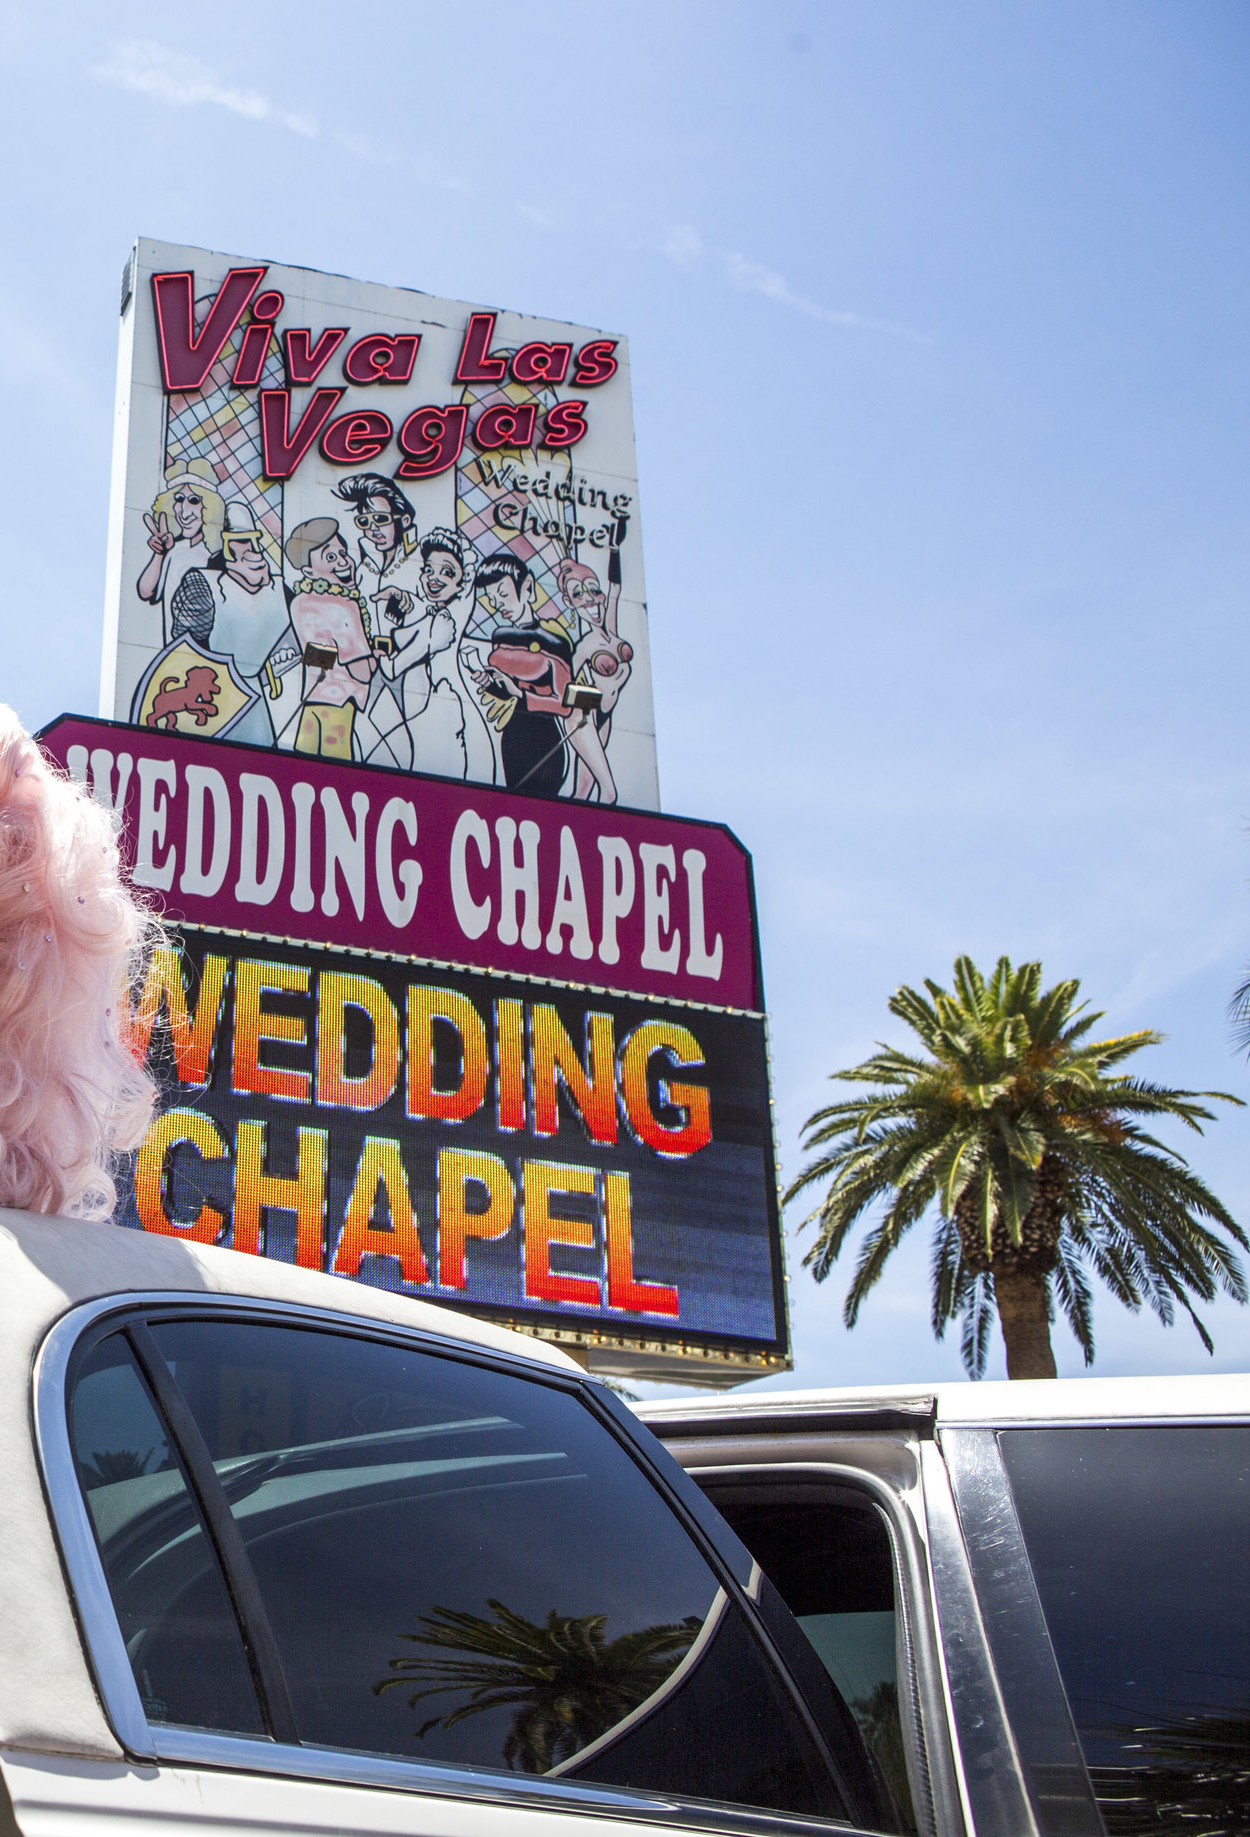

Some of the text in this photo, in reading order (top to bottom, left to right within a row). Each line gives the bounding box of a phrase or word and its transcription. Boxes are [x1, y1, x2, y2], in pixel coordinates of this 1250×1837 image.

[151, 265, 620, 395] Viva Las
[258, 386, 589, 481] Vegas
[477, 458, 633, 521] Wedding
[493, 501, 620, 550] Chapel
[450, 809, 724, 981] CHAPEL
[118, 945, 713, 1160] WEDDING
[134, 1106, 680, 1318] CHAPEL
